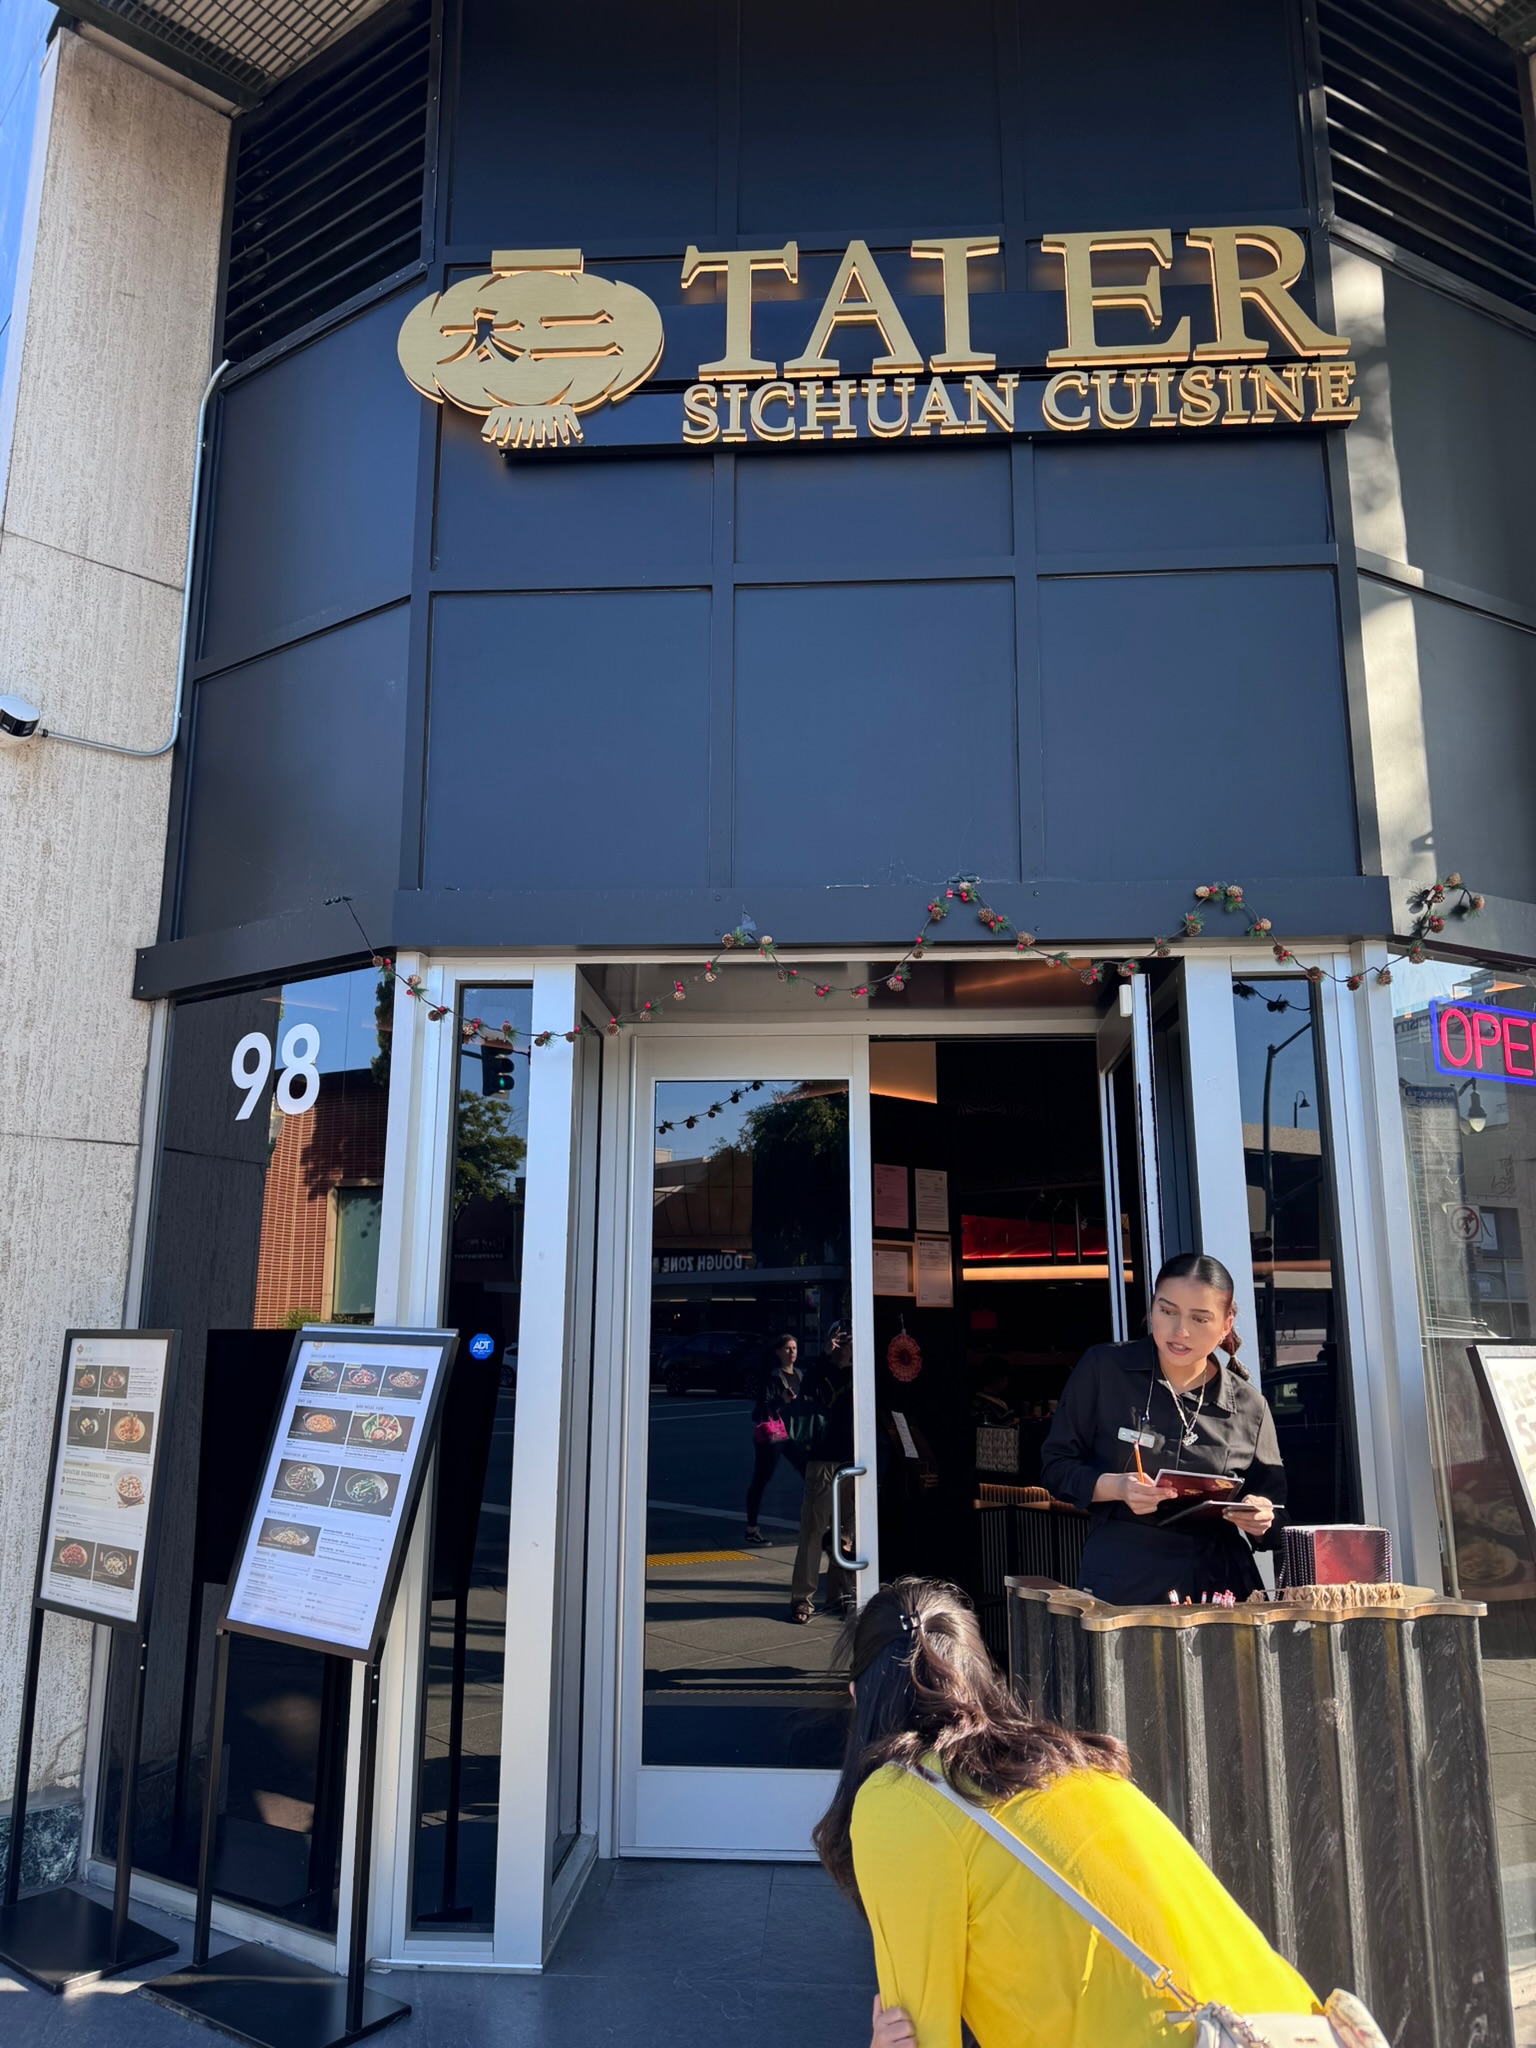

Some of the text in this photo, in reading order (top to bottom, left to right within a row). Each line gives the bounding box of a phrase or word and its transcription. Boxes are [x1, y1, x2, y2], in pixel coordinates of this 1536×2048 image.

[436, 308, 623, 364] 太二
[681, 226, 1351, 382] TAI ER
[681, 361, 1360, 444] SICHUAN CUISINE
[231, 1024, 320, 1121] 98
[1440, 1008, 1536, 1077] OPE
[473, 1340, 491, 1350] ADT
